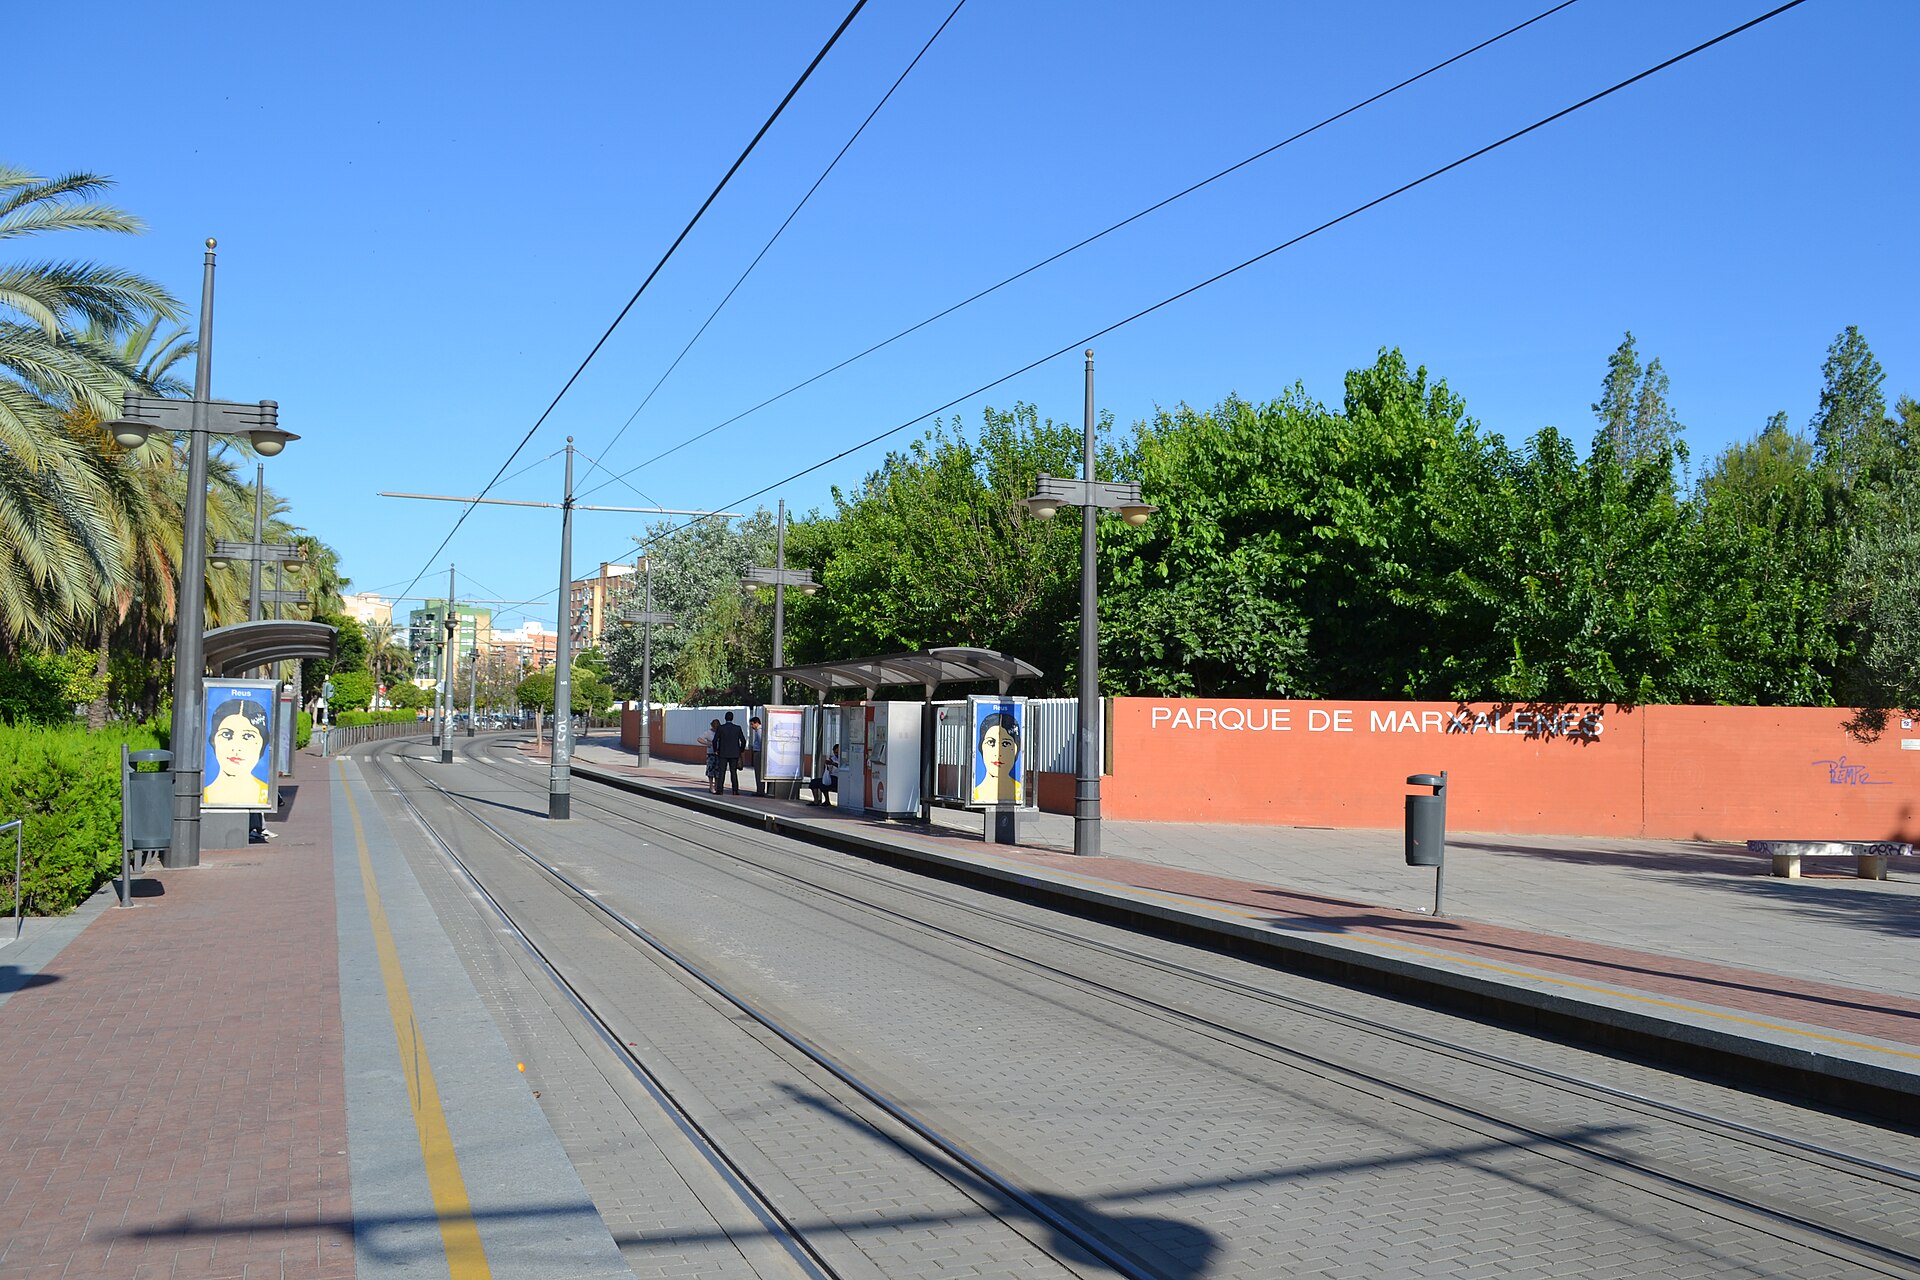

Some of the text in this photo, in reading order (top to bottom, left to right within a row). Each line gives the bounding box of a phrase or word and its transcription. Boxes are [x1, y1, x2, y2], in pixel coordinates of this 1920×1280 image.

[231, 689, 252, 697] Reus
[1151, 707, 1604, 736] PARQUE DE MARXALENES
